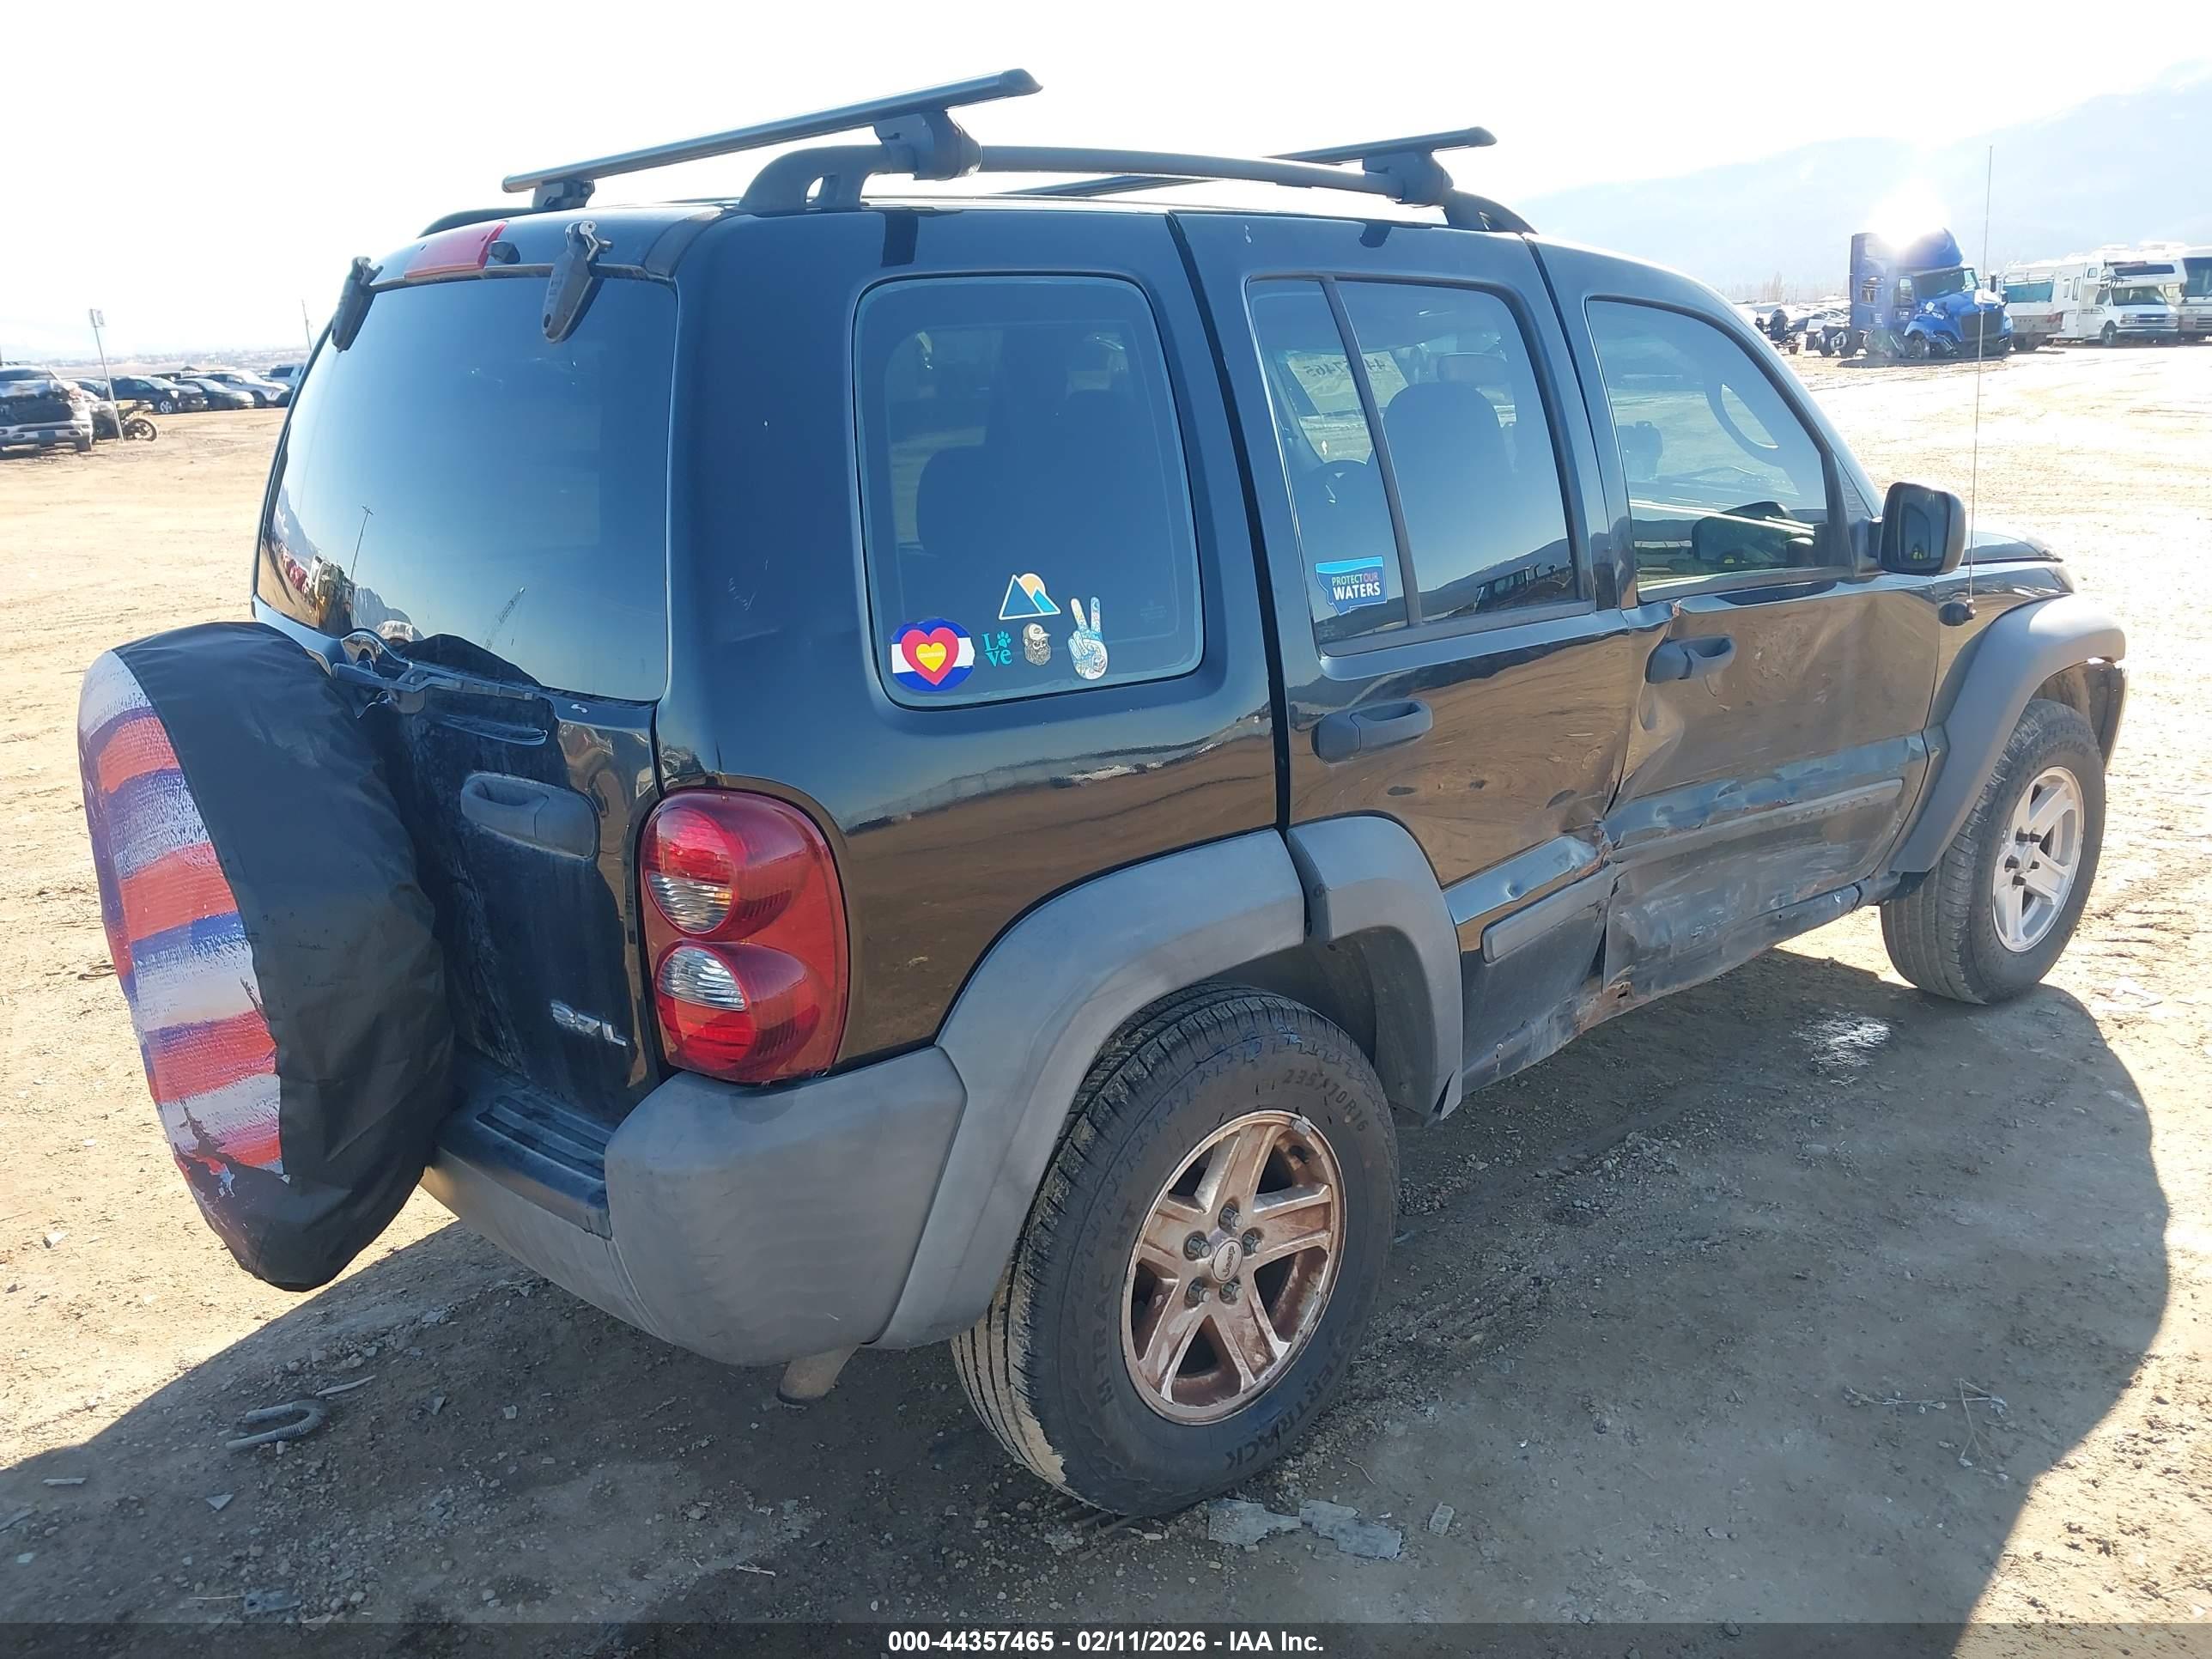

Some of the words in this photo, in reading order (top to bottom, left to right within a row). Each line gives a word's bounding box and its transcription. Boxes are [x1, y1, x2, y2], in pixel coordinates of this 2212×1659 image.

[1331, 573, 1363, 586] PROTECT
[1363, 571, 1379, 583] OUR
[1333, 581, 1381, 601] WATERS
[1222, 1245, 1236, 1278] Jeep
